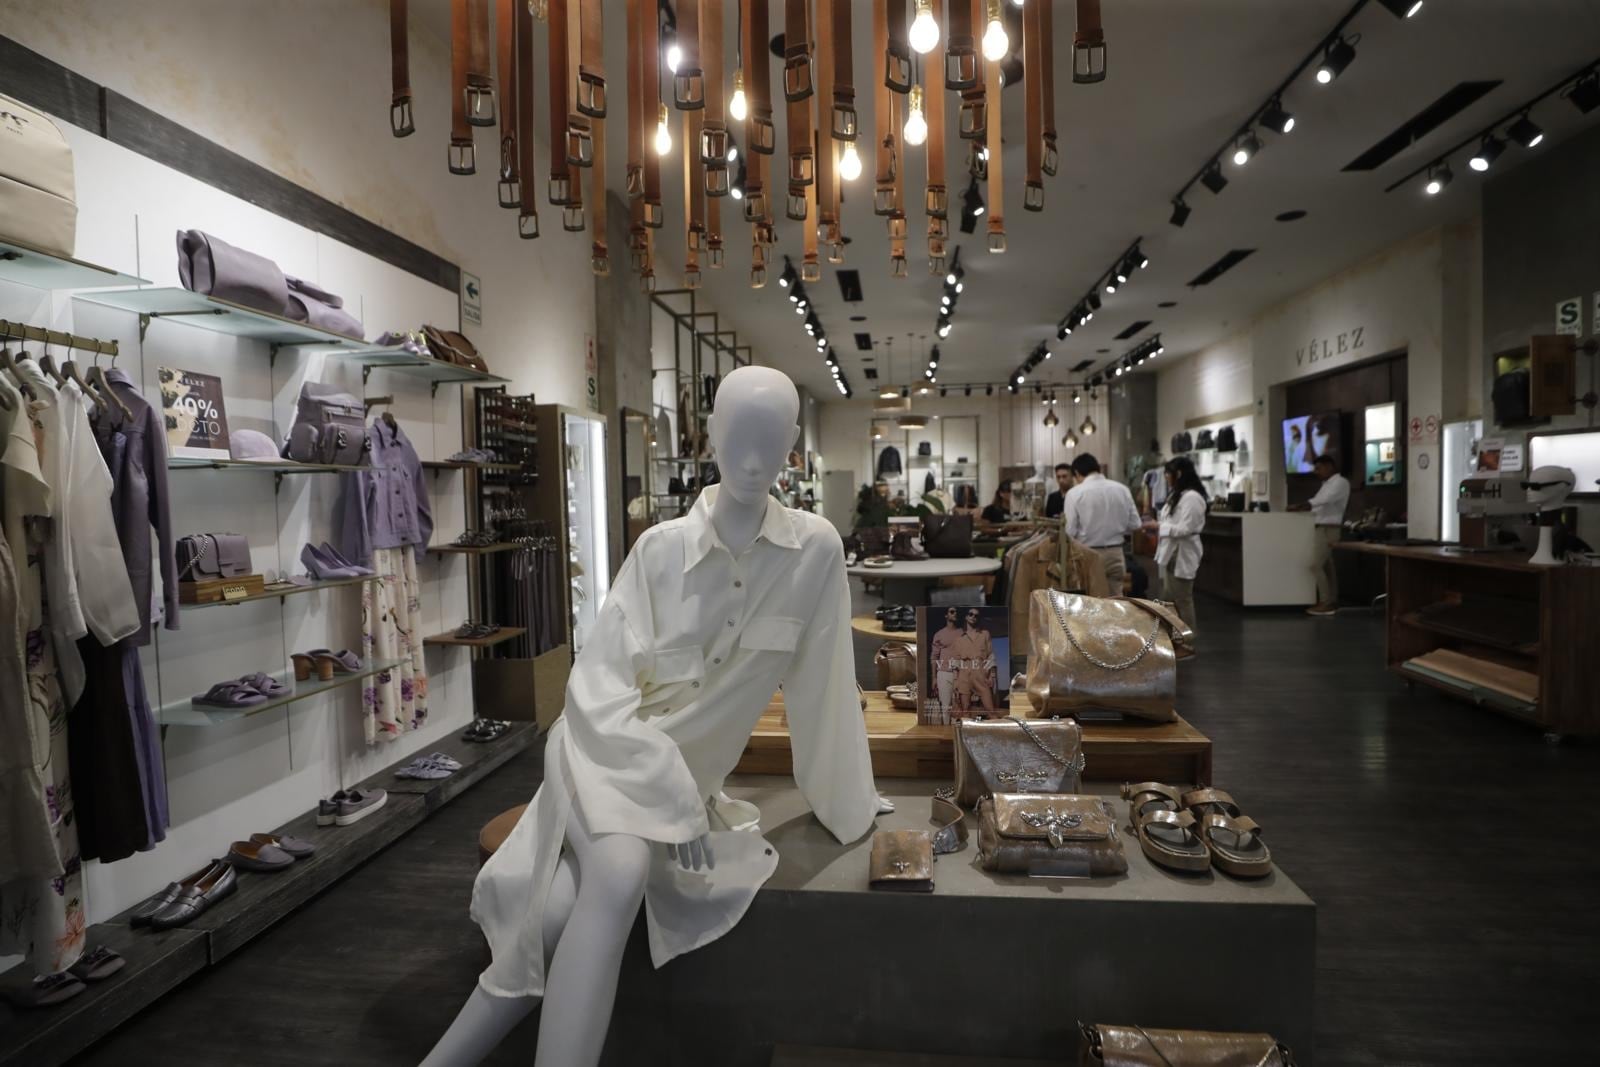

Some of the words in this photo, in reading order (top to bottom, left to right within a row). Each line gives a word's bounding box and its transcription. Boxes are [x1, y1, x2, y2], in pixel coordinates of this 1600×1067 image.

[1560, 302, 1578, 325] S
[1296, 326, 1364, 367] VÉLEZ
[172, 397, 219, 419] 40%
